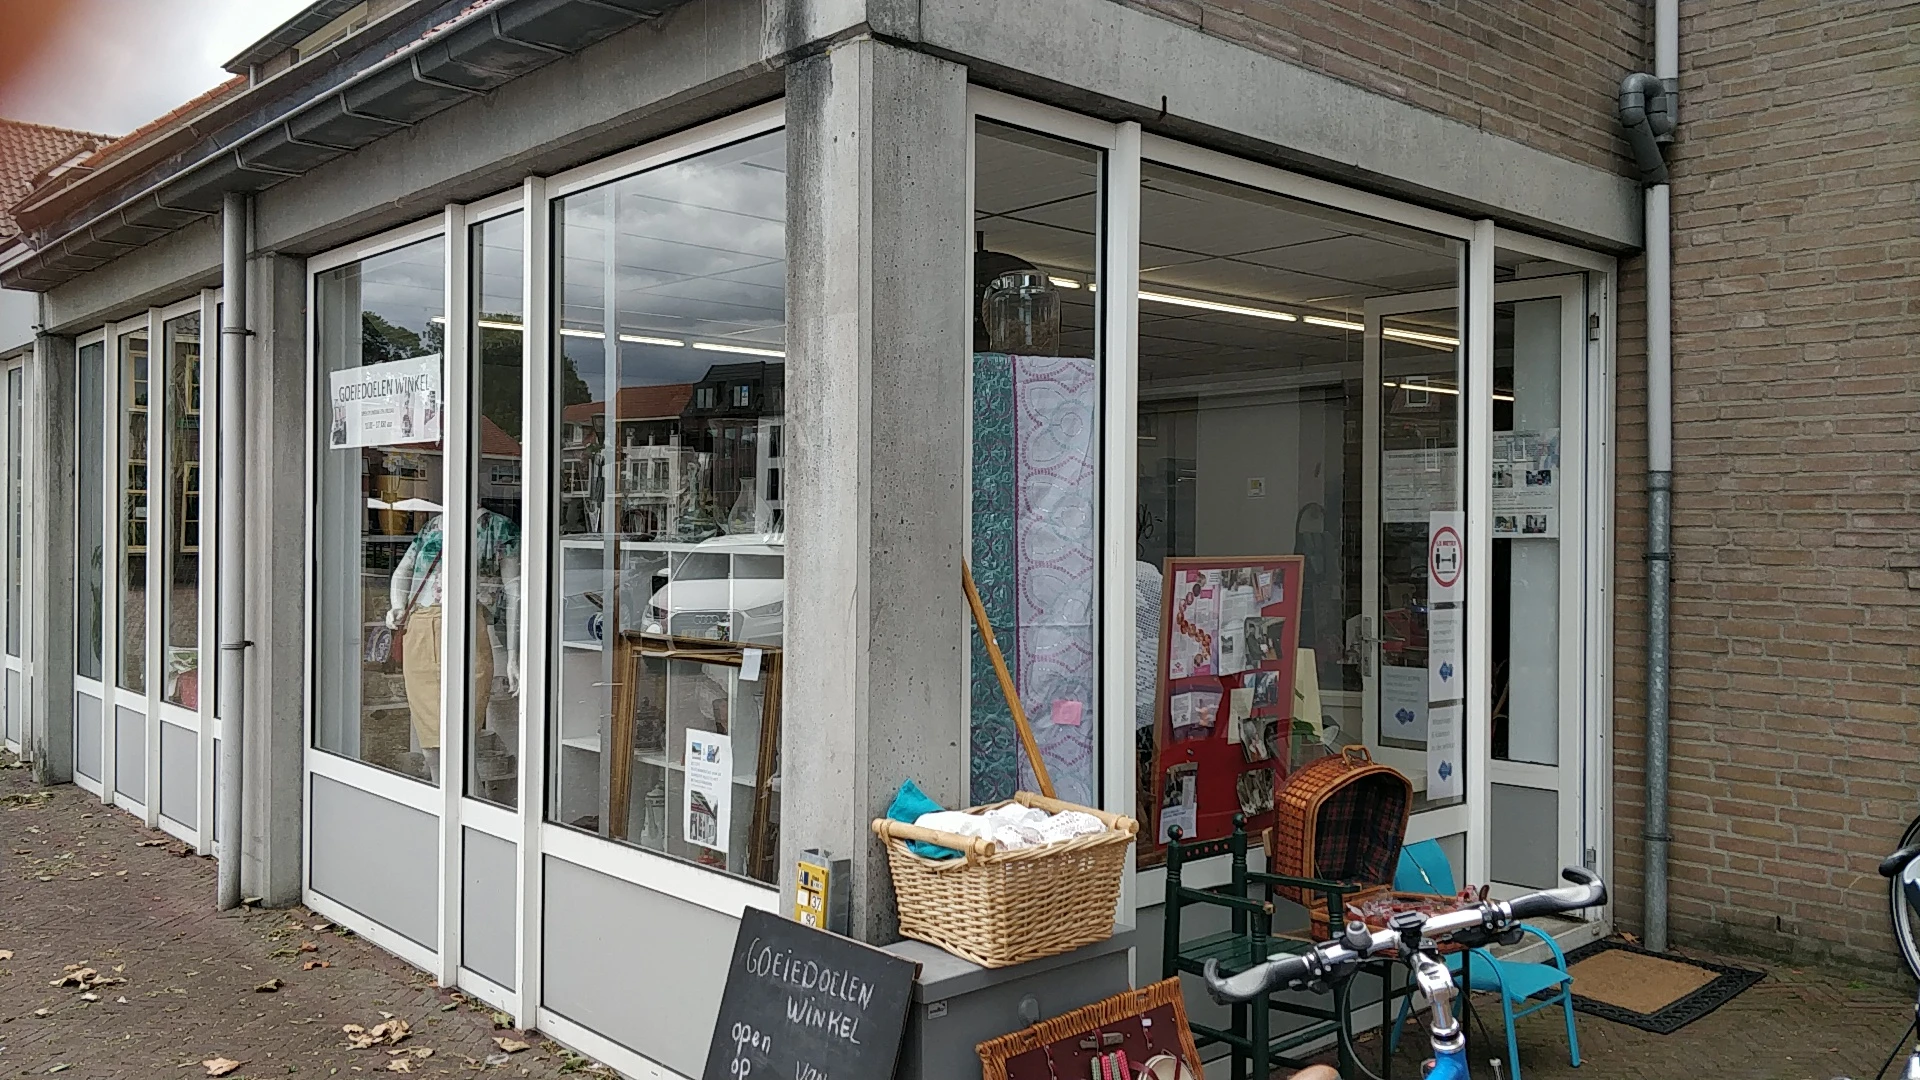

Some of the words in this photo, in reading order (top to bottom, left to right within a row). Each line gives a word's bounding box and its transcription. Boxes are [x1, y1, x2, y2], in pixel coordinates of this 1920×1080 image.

[339, 379, 393, 402] GOEIEDOELEN
[395, 374, 430, 395] WINKEL
[731, 1021, 771, 1056] open
[730, 1057, 751, 1080] op
